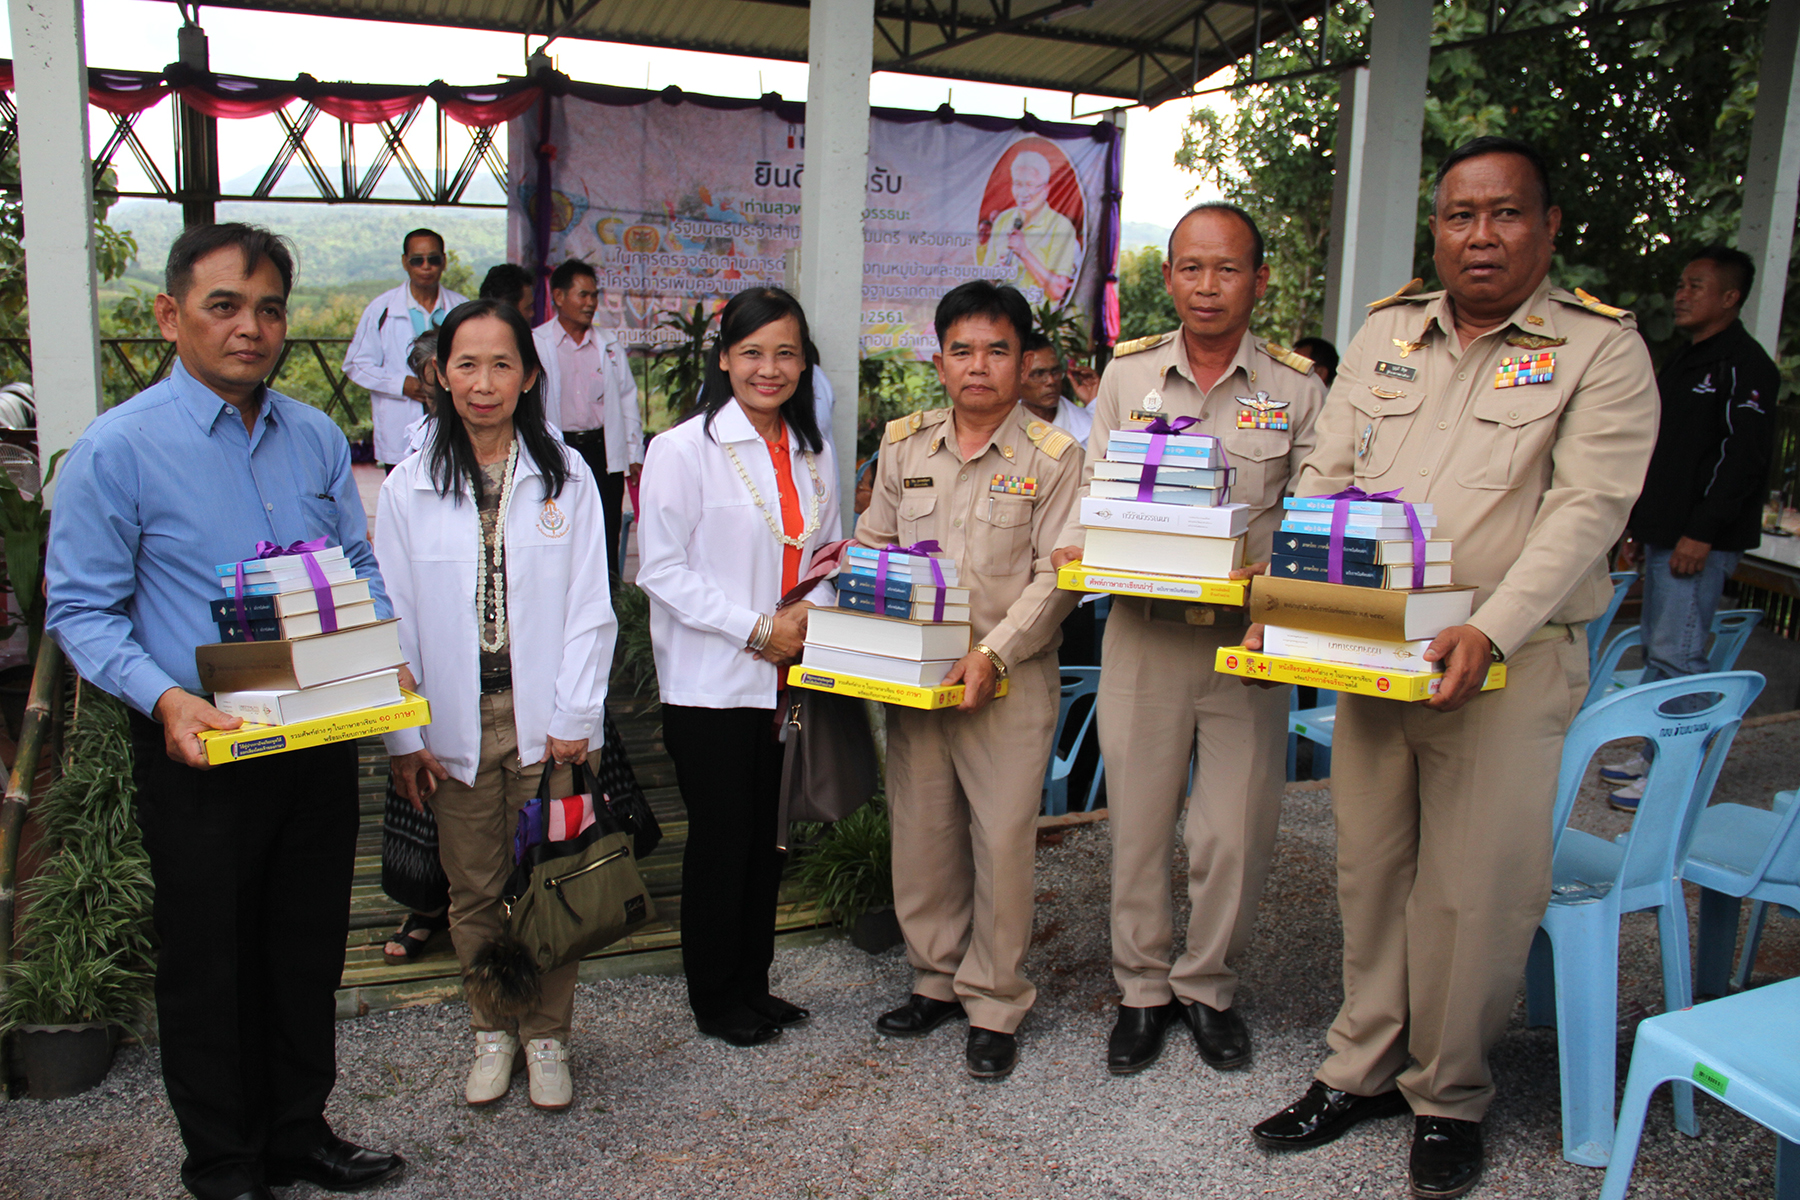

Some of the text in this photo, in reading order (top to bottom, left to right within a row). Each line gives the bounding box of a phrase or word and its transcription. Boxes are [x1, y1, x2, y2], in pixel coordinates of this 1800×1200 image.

[908, 231, 972, 247] พร้อมคณะ
[868, 311, 904, 323] 2561
[394, 710, 416, 720] ภาษา
